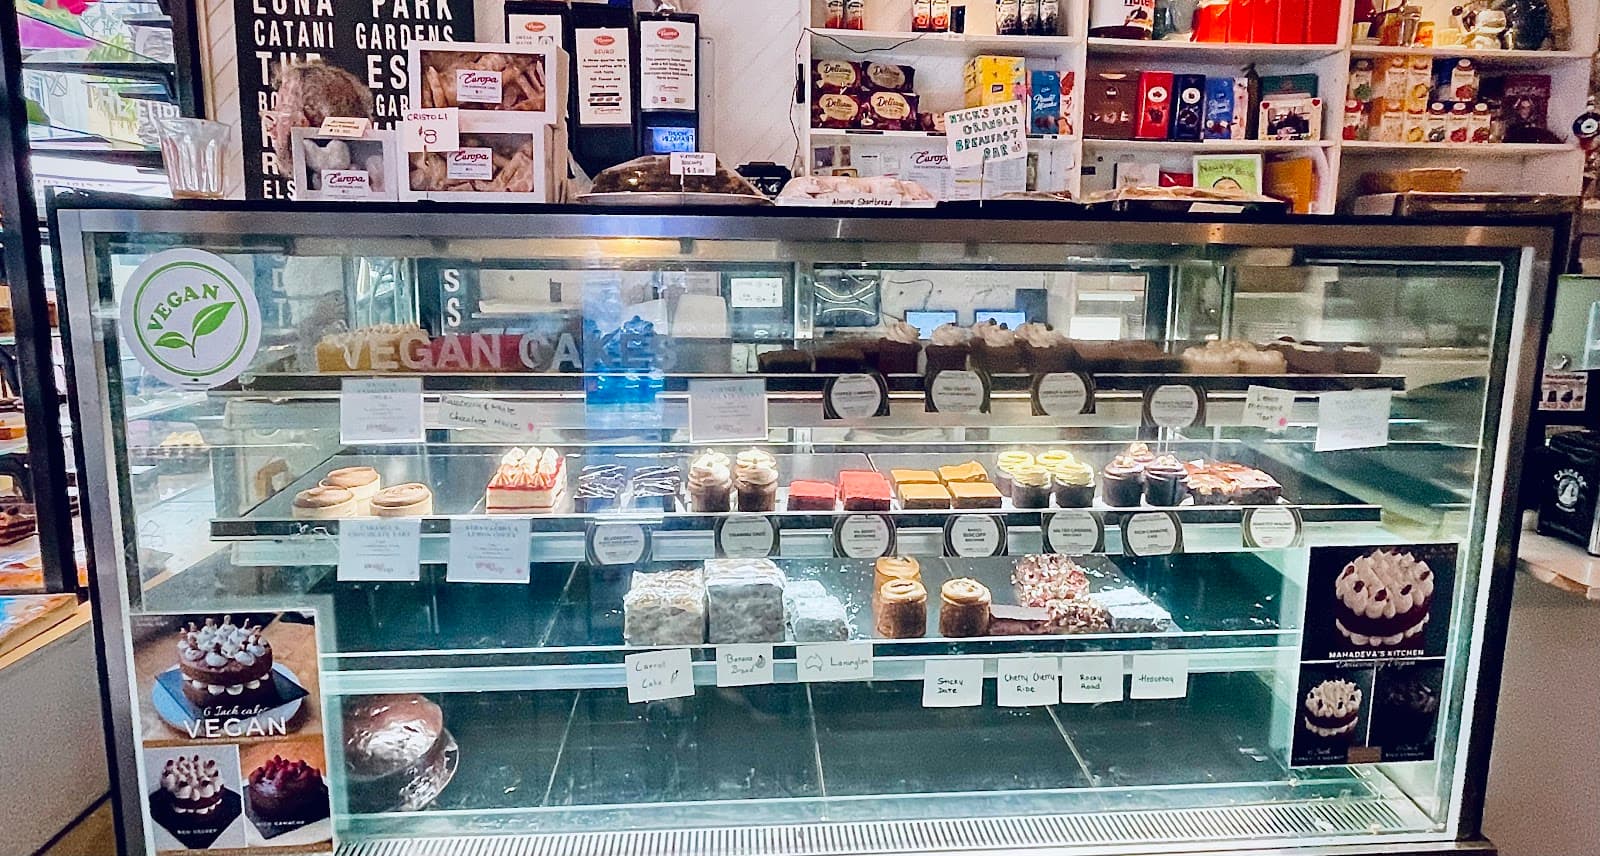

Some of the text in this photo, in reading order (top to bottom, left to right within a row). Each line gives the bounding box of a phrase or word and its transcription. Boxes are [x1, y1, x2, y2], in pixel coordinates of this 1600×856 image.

[372, 0, 453, 21] PARK
[254, 19, 454, 50] CATANI GARDENS
[459, 72, 499, 86] Europa
[449, 150, 489, 163] Europa
[324, 172, 366, 185] Europa
[147, 283, 219, 330] VEGAN
[342, 332, 502, 371] VEGAN
[1328, 649, 1425, 659] MAHADEVA'S KITCHEN
[183, 715, 288, 740] VEGAN
